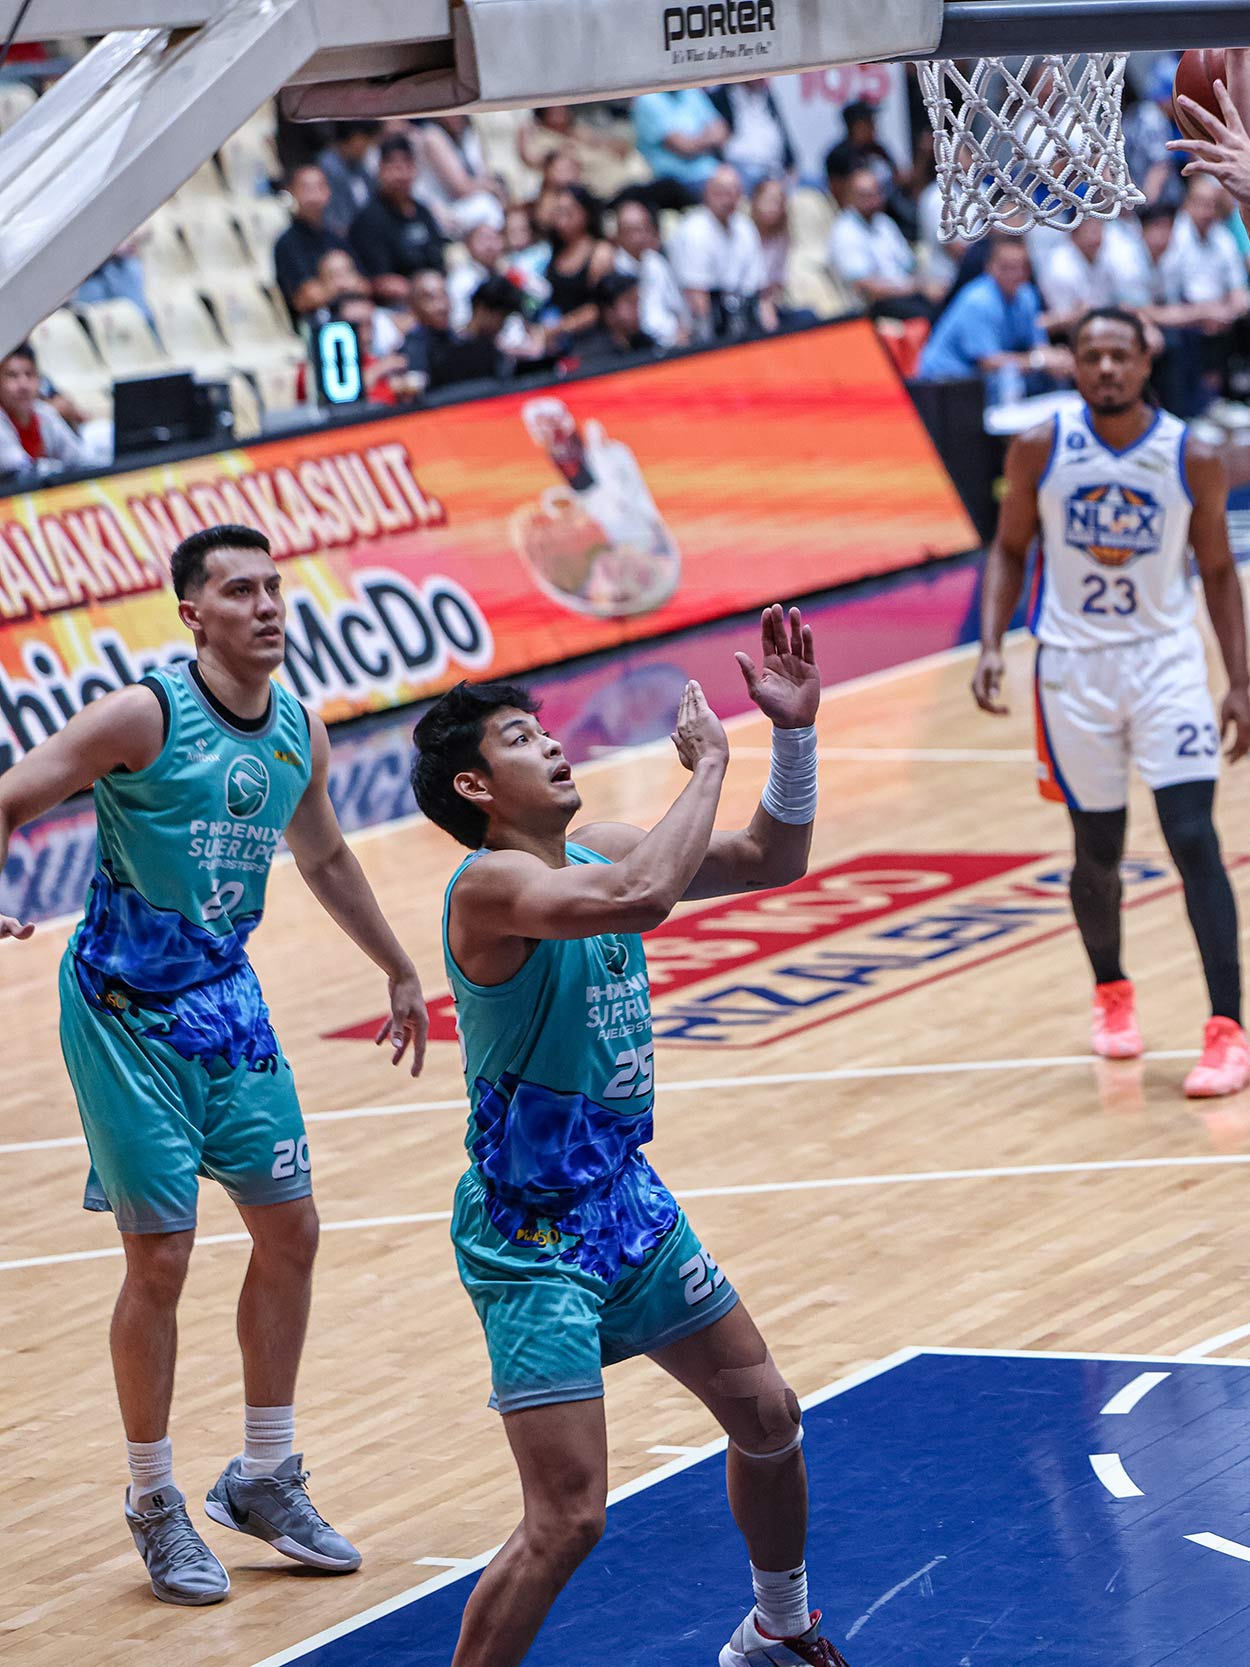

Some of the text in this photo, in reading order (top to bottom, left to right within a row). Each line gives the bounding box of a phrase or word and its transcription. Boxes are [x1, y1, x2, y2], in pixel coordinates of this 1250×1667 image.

[318, 321, 361, 404] 0
[1082, 574, 1138, 616] 23
[1177, 723, 1218, 757] 23
[602, 1041, 654, 1099] 25
[272, 1134, 311, 1181] 20
